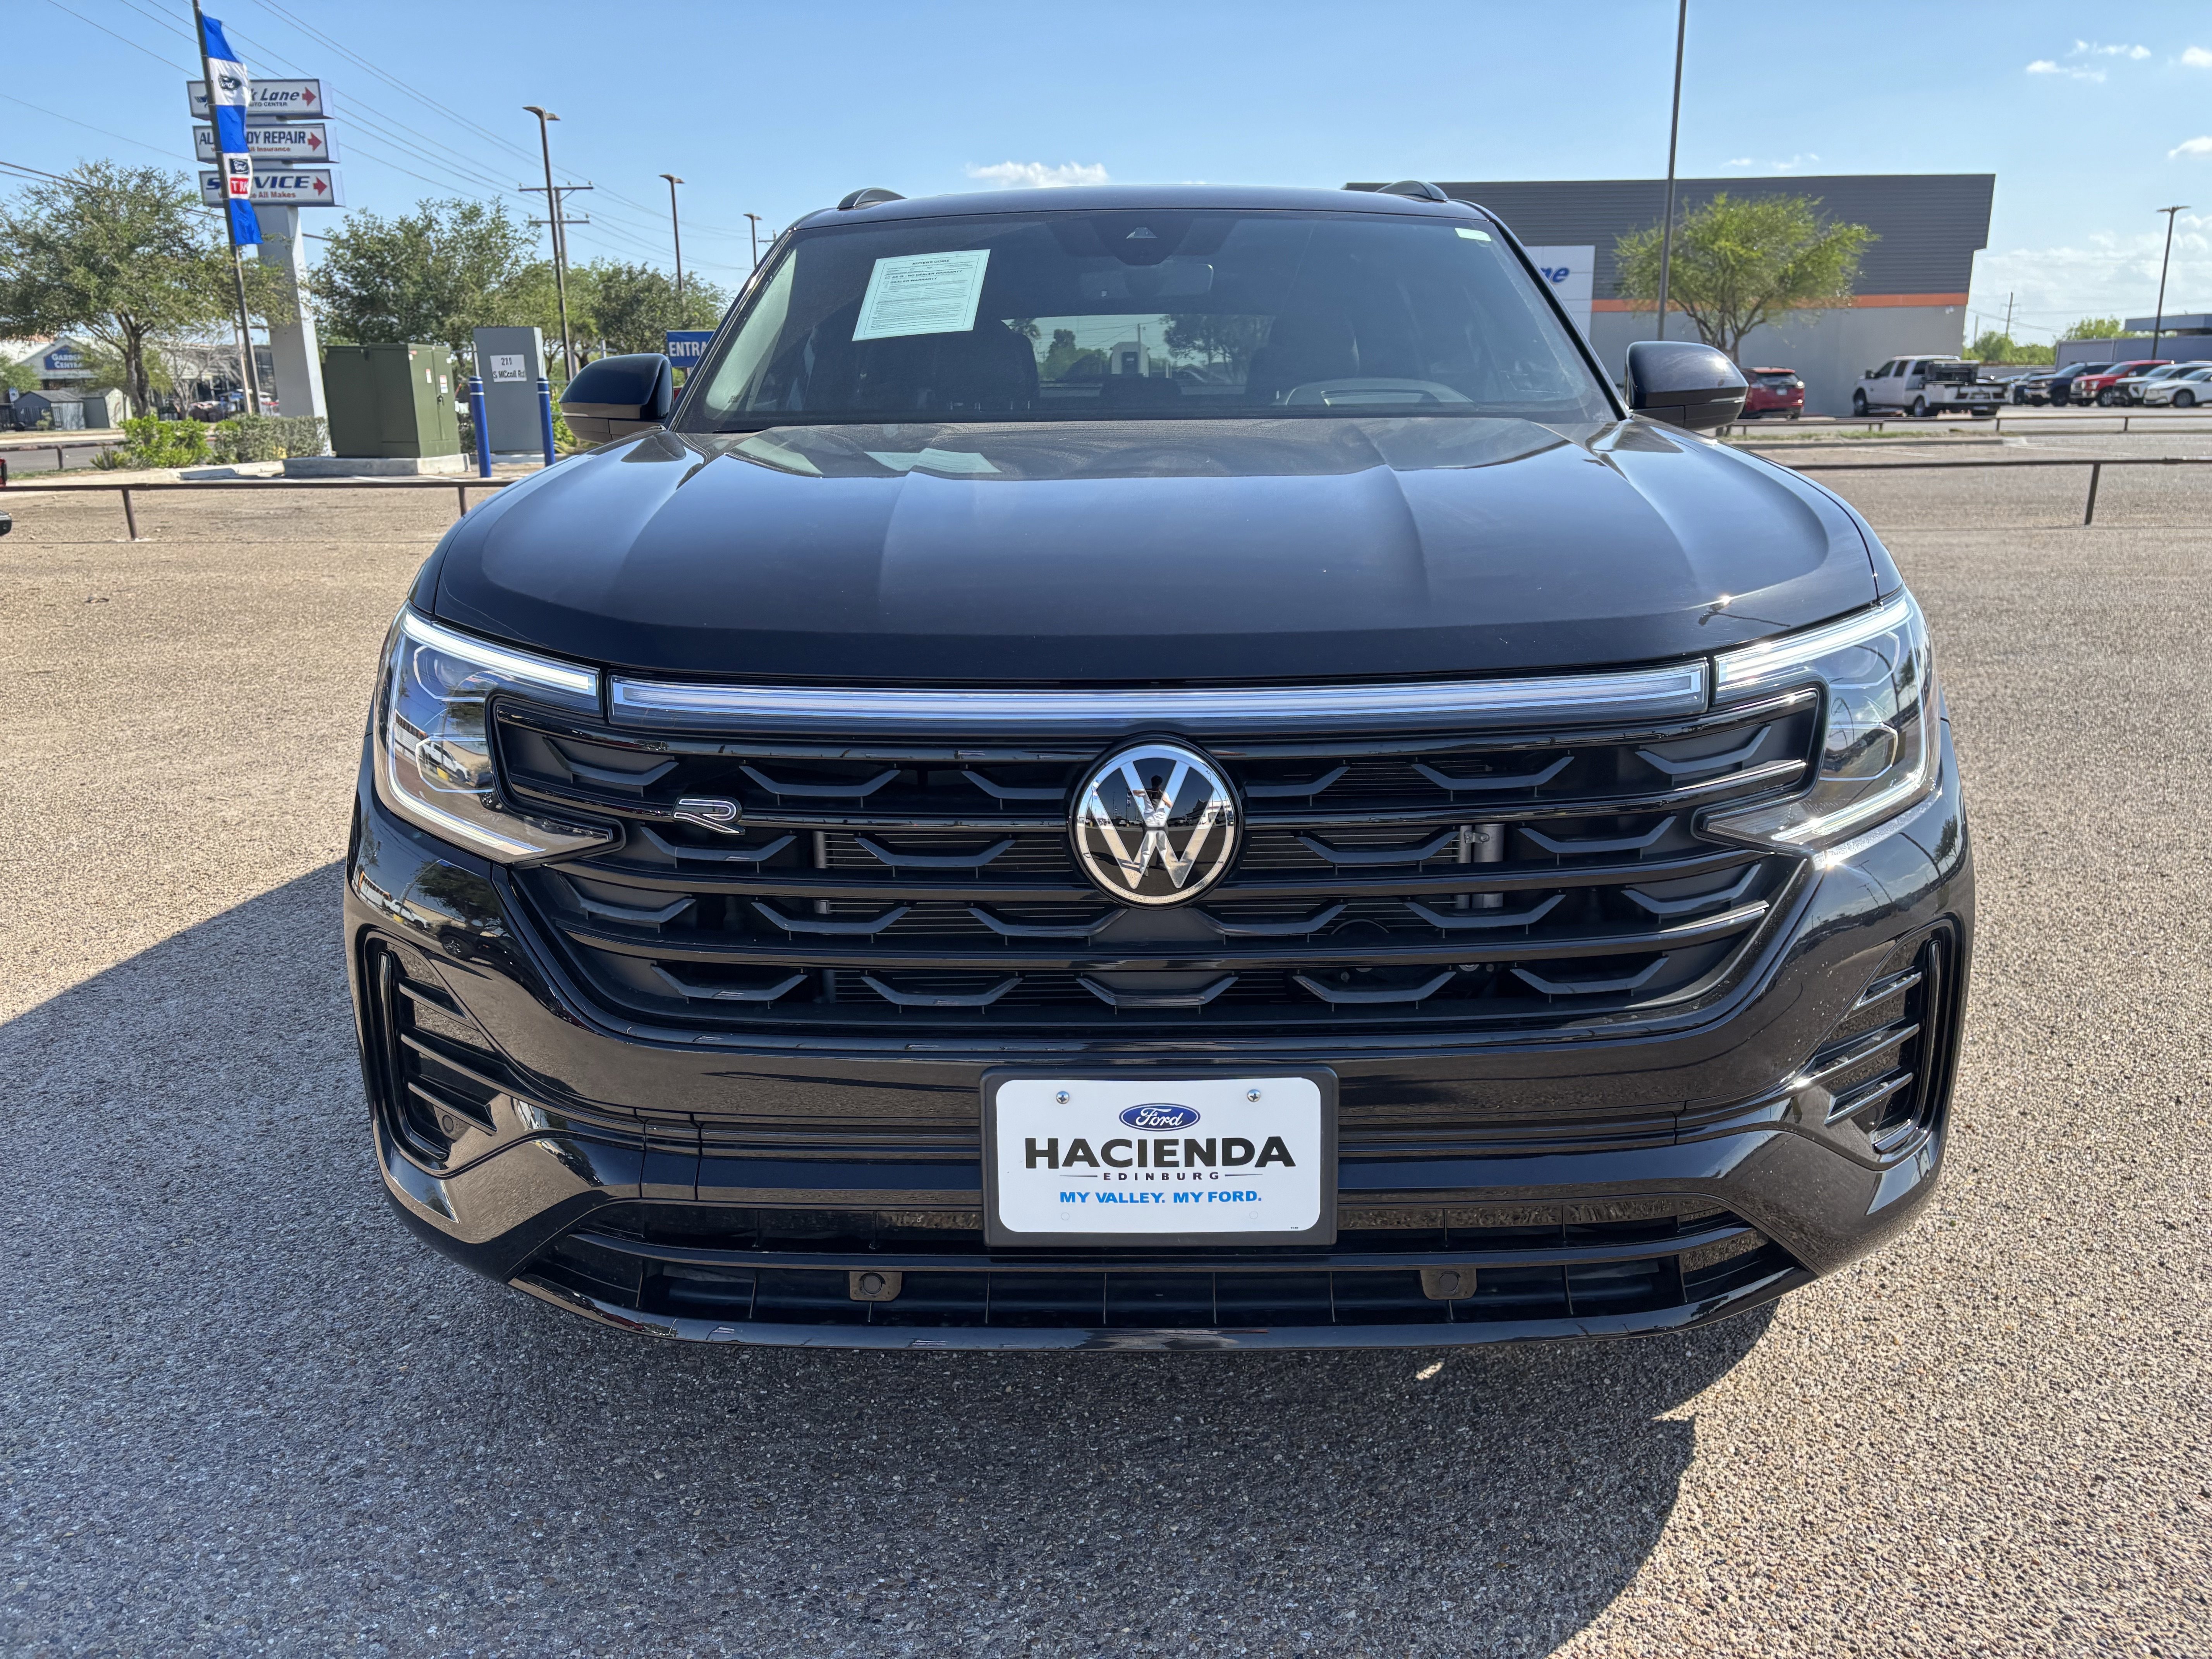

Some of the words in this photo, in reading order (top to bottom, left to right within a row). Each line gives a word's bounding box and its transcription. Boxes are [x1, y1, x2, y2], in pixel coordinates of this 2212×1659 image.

[260, 88, 299, 101] Lane
[264, 131, 306, 144] REPAIR
[206, 176, 310, 190] SVICE
[501, 357, 512, 366] 211
[1135, 1107, 1184, 1126] Ford
[1025, 1136, 1296, 1169] HACIENDA
[1103, 1172, 1219, 1180] EDINBURG
[1060, 1192, 1090, 1203] MY
[1095, 1192, 1165, 1203] VALLEY.
[1173, 1192, 1204, 1203] MY
[1208, 1190, 1262, 1202] FORD.
